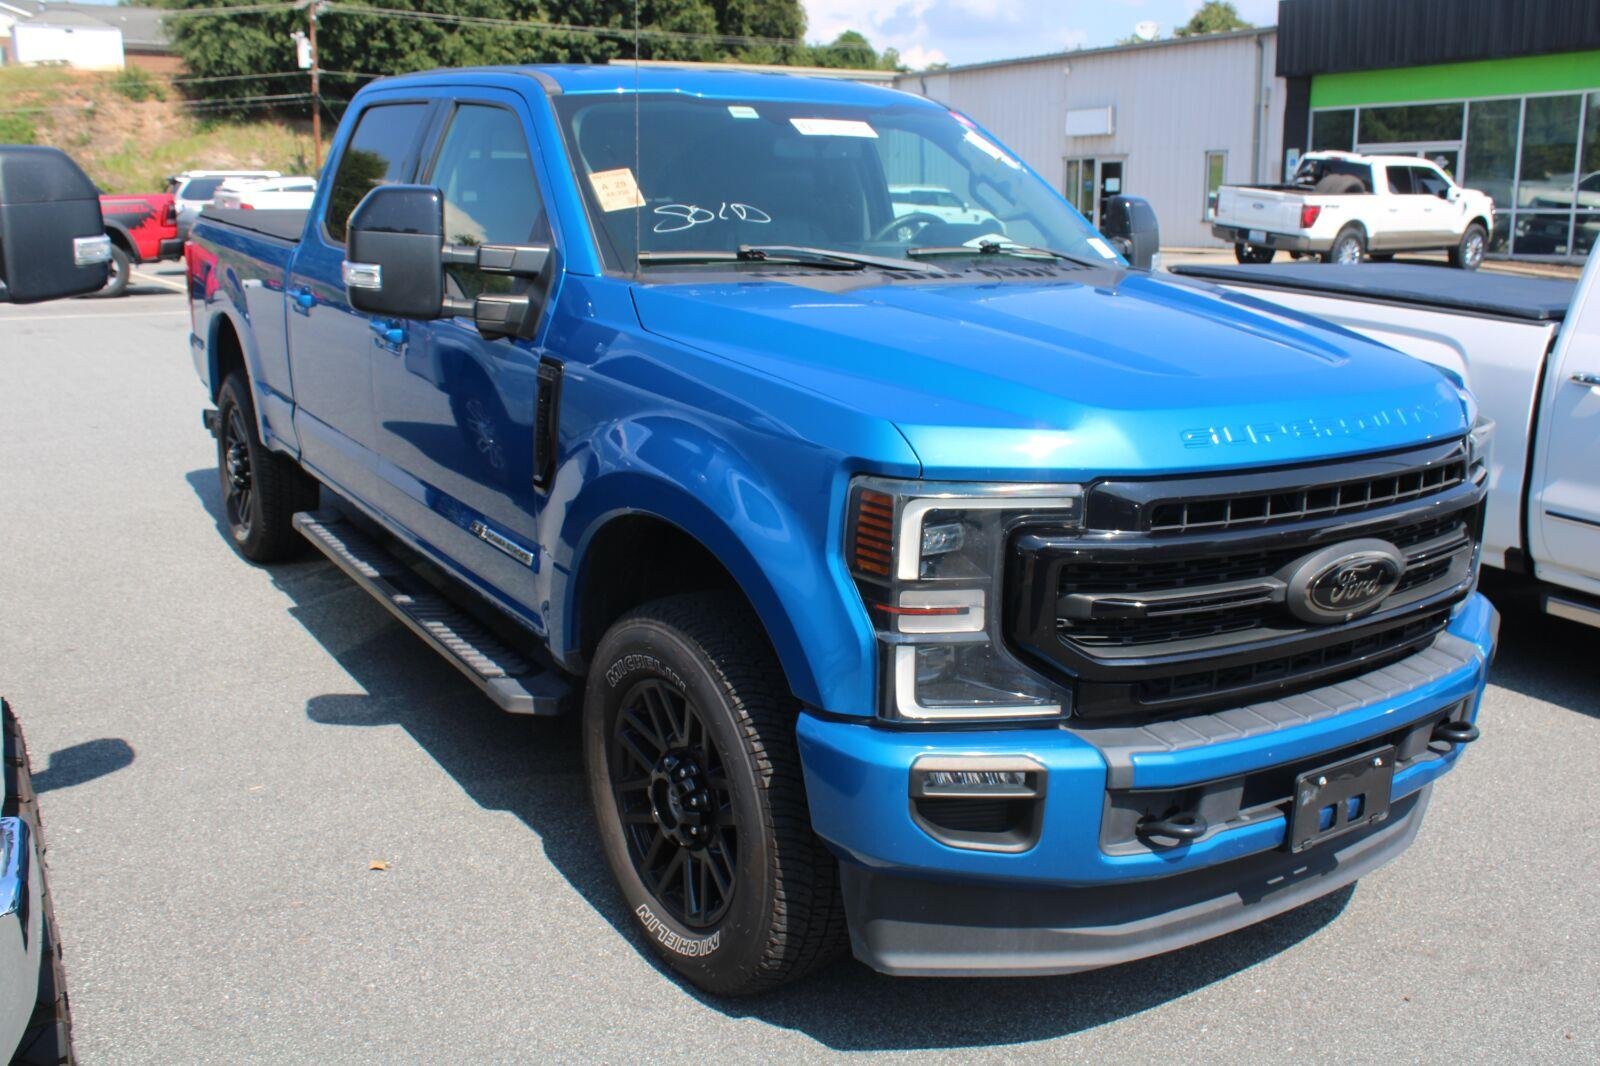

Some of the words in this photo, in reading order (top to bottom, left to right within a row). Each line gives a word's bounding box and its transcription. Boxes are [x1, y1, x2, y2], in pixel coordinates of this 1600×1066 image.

[1179, 416, 1338, 450] SUPER
[1340, 401, 1440, 435] DUTY
[1329, 565, 1385, 604] Ford
[605, 653, 687, 689] MICHELIN
[634, 903, 720, 957] MICHELIN
